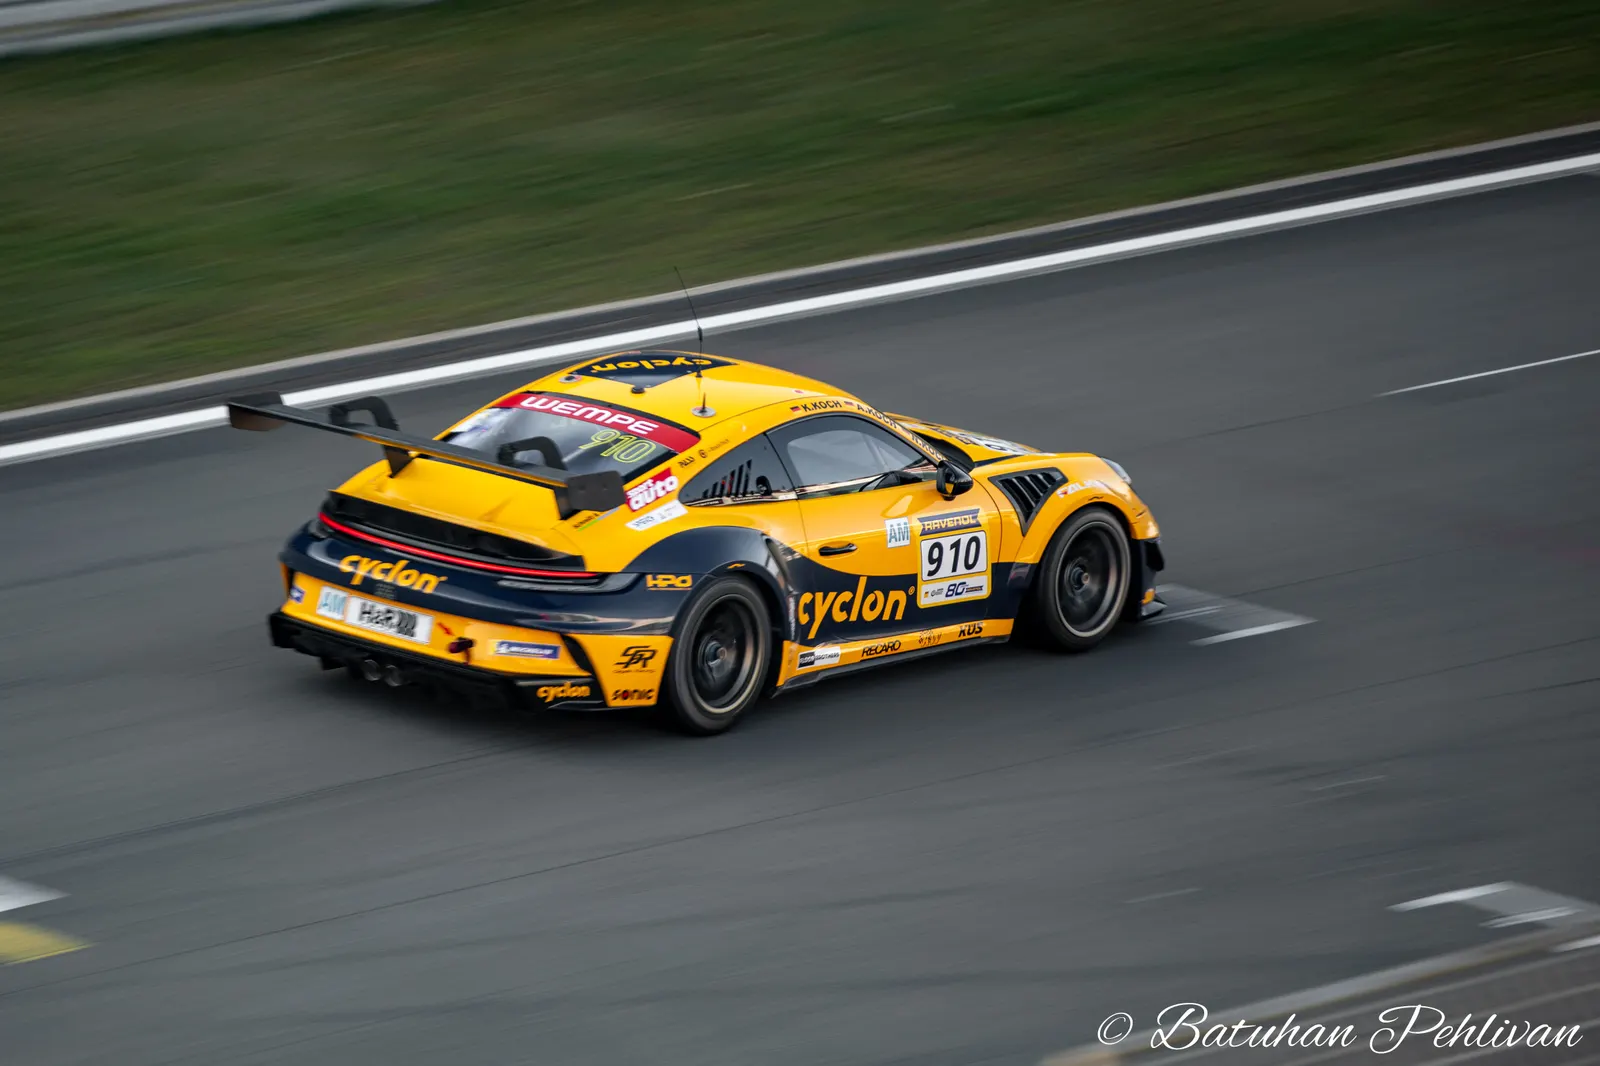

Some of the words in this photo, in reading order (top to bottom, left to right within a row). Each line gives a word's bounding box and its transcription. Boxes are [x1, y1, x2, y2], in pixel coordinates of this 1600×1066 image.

[590, 356, 712, 374] cyclon
[520, 396, 659, 435] WEMPE
[801, 400, 843, 413] K.KOCH
[578, 429, 657, 464] 910
[629, 475, 679, 511] auto
[888, 521, 910, 544] AM
[923, 514, 977, 532] RAVENOL
[926, 535, 981, 577] 910
[339, 554, 439, 595] cyclon
[861, 639, 902, 658] RECARO
[536, 680, 591, 702] cyclon
